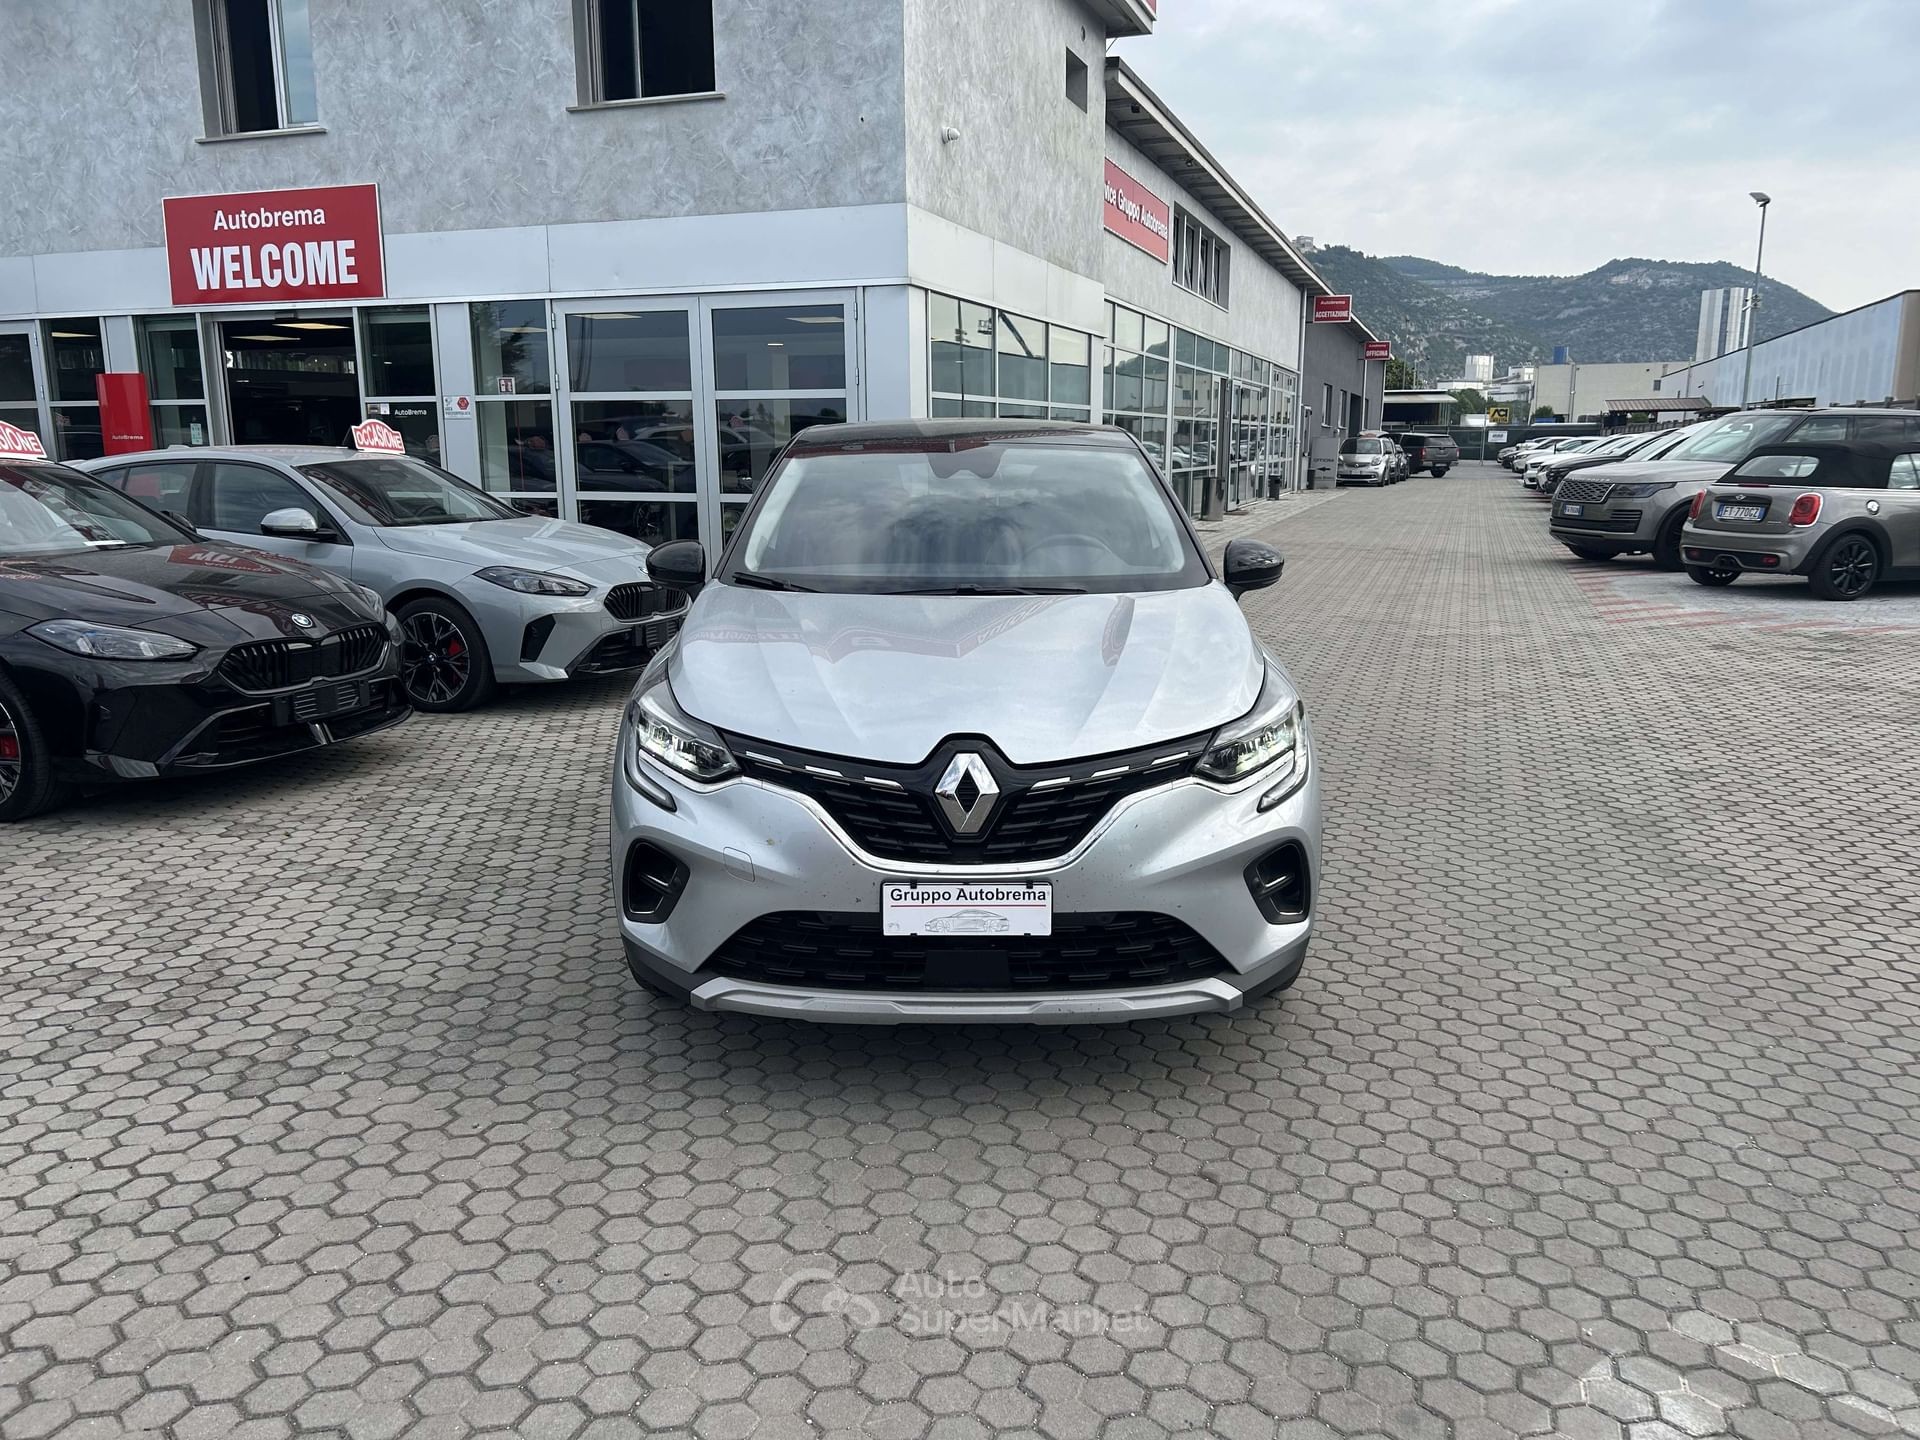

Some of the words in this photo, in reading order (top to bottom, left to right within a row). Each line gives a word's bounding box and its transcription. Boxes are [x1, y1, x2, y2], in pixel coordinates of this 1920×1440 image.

[213, 207, 326, 231] Autobrema
[1118, 188, 1140, 223] Gruppo
[1141, 205, 1168, 240] Autobrema
[189, 239, 359, 291] WELCOME
[1315, 310, 1349, 318] ACCETTAZIONE
[394, 408, 428, 417] AutoBrema
[355, 423, 405, 450] OCCASIONE
[890, 888, 952, 904] Gruppo
[956, 888, 1047, 902] Autobrema
